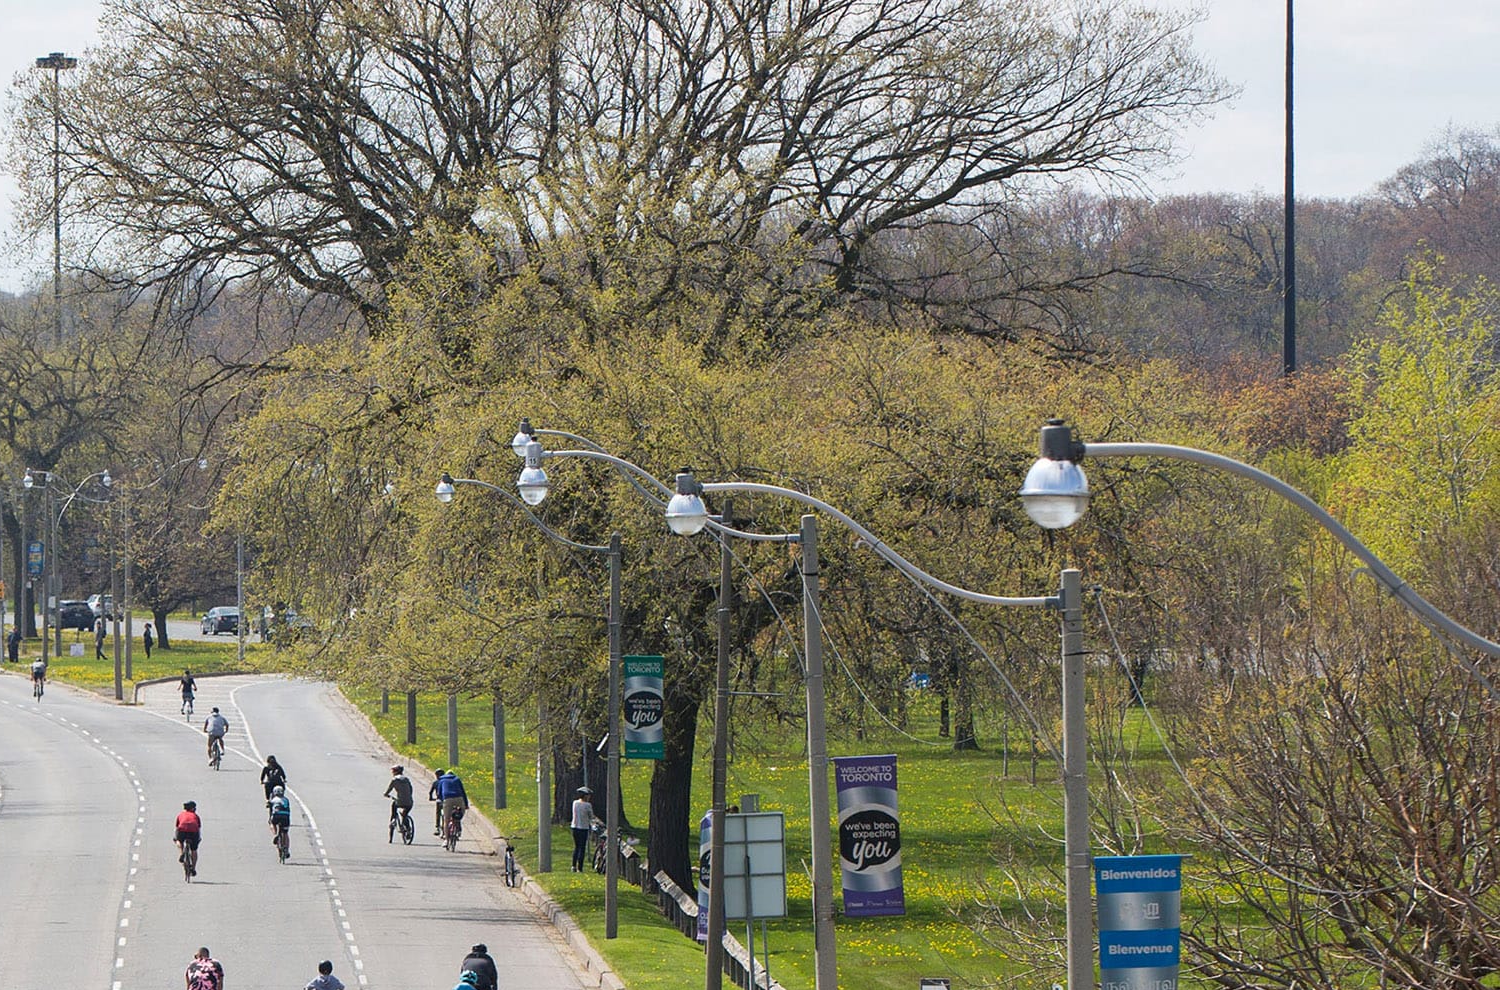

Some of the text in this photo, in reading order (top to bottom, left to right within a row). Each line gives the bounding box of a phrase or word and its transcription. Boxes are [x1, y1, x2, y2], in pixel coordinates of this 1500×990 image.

[632, 710, 657, 728] you
[841, 773, 892, 782] TORONTO
[873, 821, 896, 830] been
[852, 830, 896, 839] expecting
[852, 840, 892, 869] you
[1101, 868, 1177, 880] Bienvenidos
[1108, 944, 1173, 955] Bienvenue
